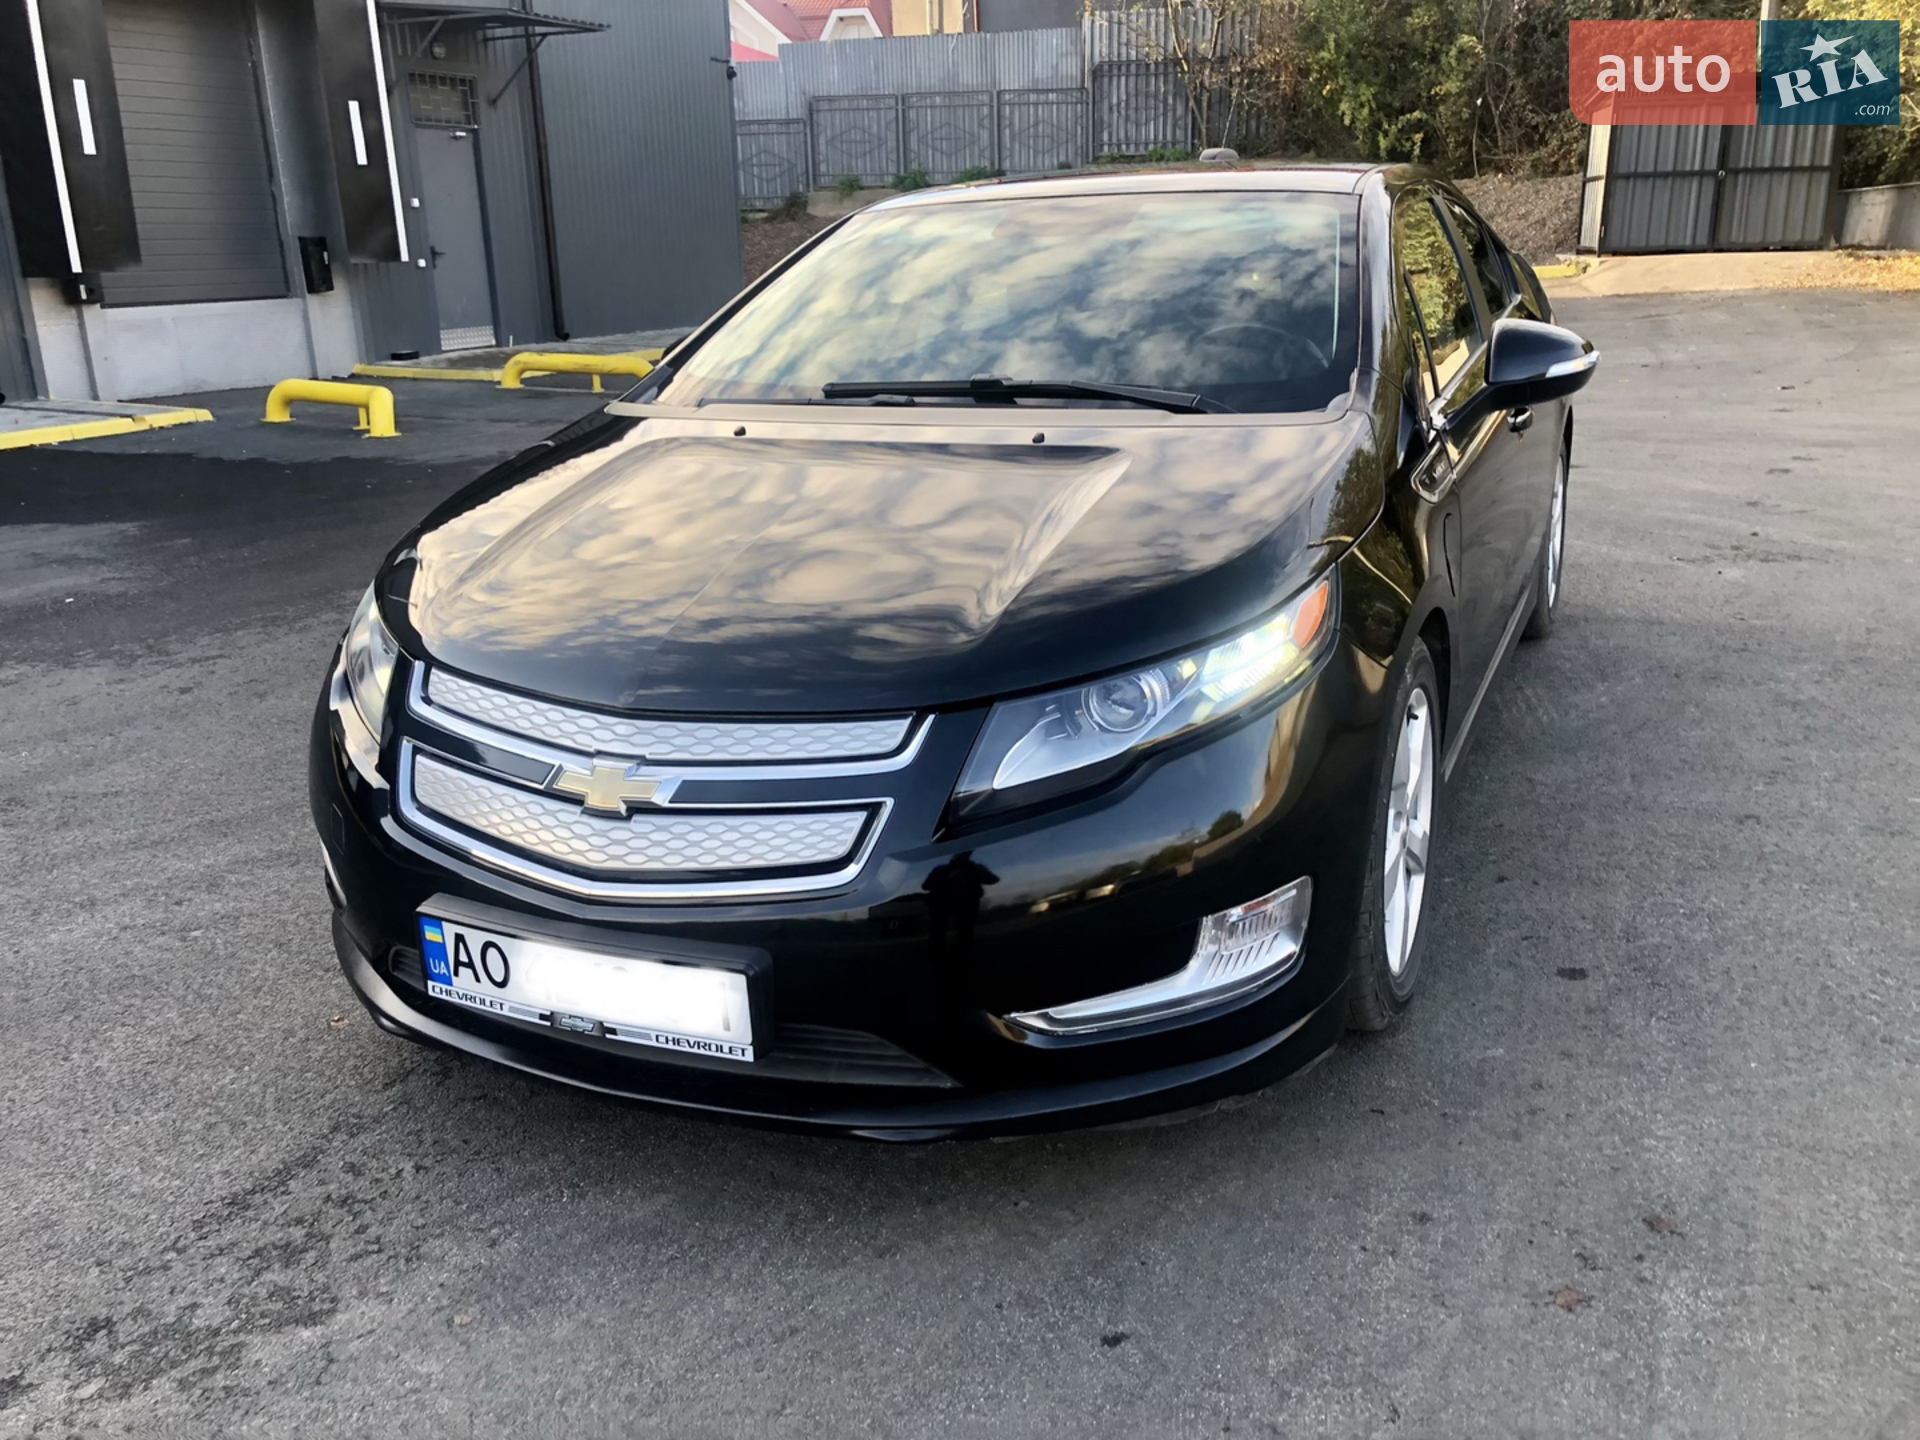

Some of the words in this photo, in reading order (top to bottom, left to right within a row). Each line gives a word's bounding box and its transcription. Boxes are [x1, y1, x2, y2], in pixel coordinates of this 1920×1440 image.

[429, 957, 450, 977] UA
[453, 931, 511, 989] AO
[431, 984, 506, 1012] CHEVROLET
[655, 1033, 748, 1058] CHEVROLET
